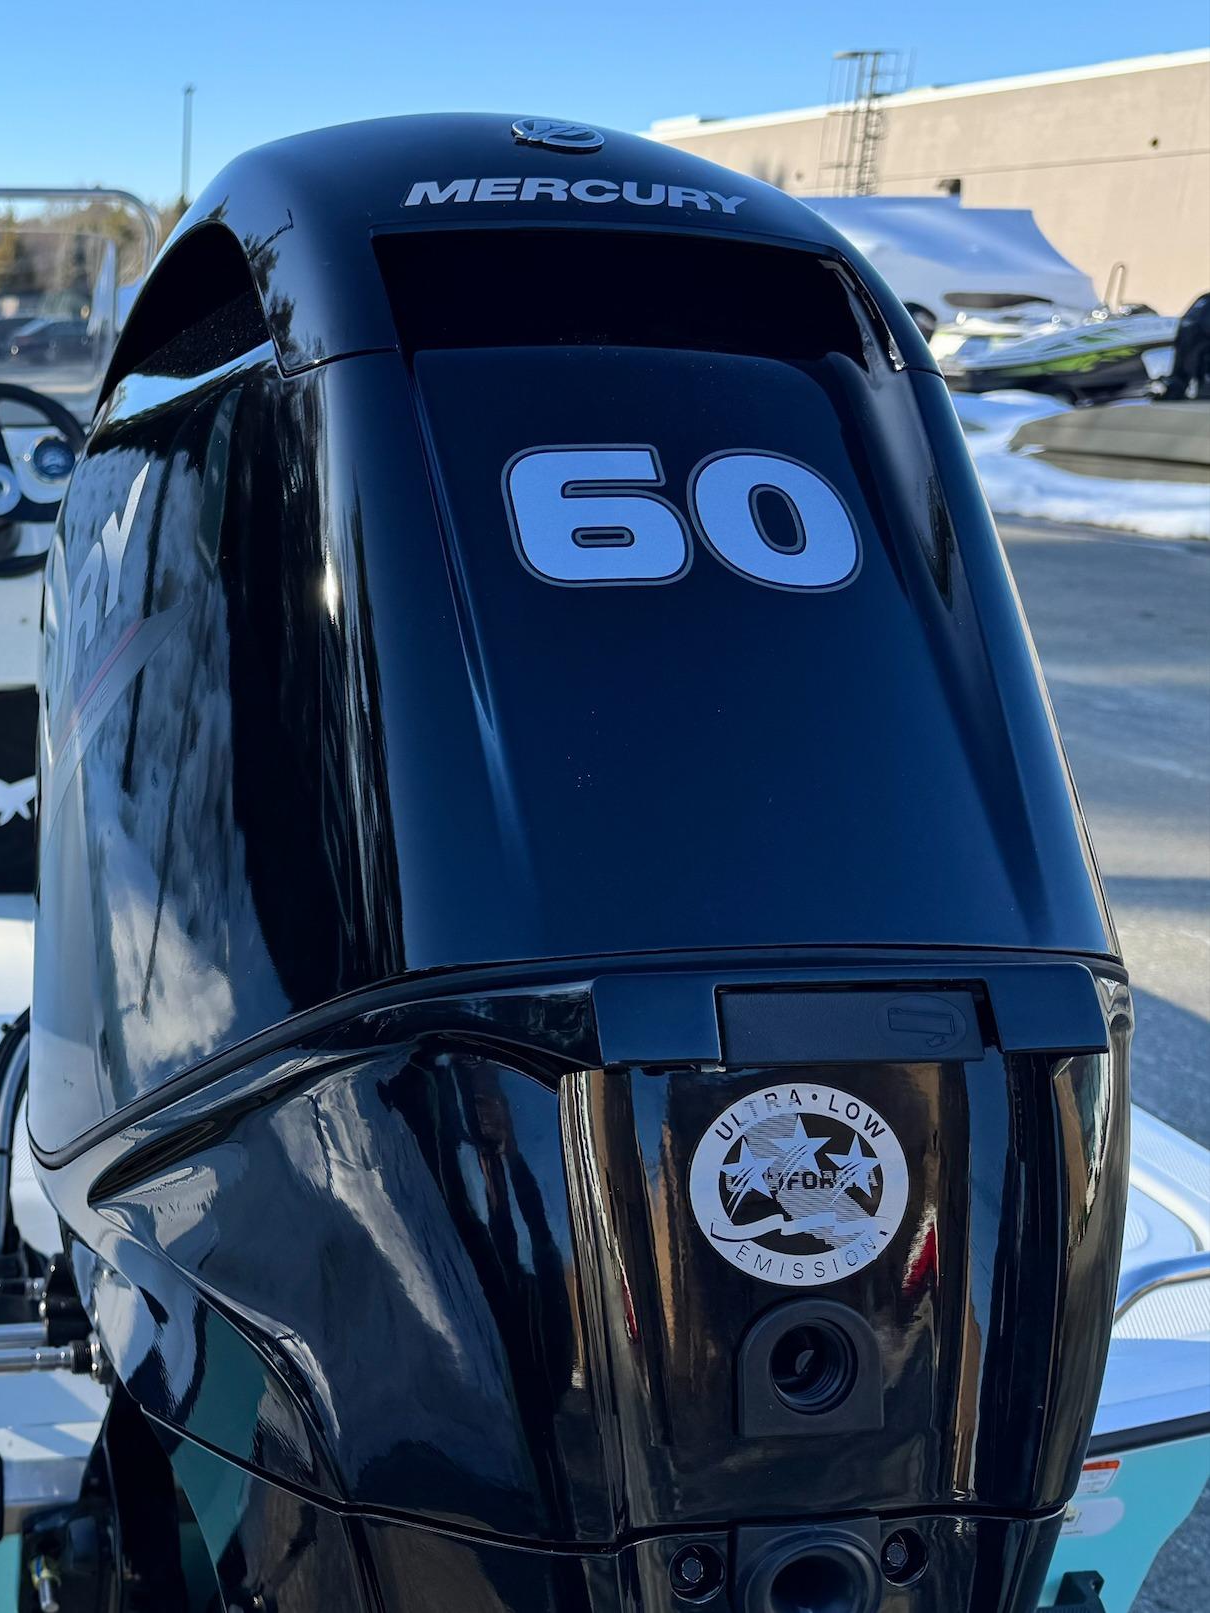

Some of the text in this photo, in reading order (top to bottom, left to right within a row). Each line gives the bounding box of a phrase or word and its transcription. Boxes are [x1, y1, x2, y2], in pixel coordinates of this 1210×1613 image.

[402, 177, 747, 215] MERCURY
[501, 443, 863, 593] 60
[715, 1088, 886, 1141] ULTRA LOW
[735, 1235, 878, 1280] EMISSION
